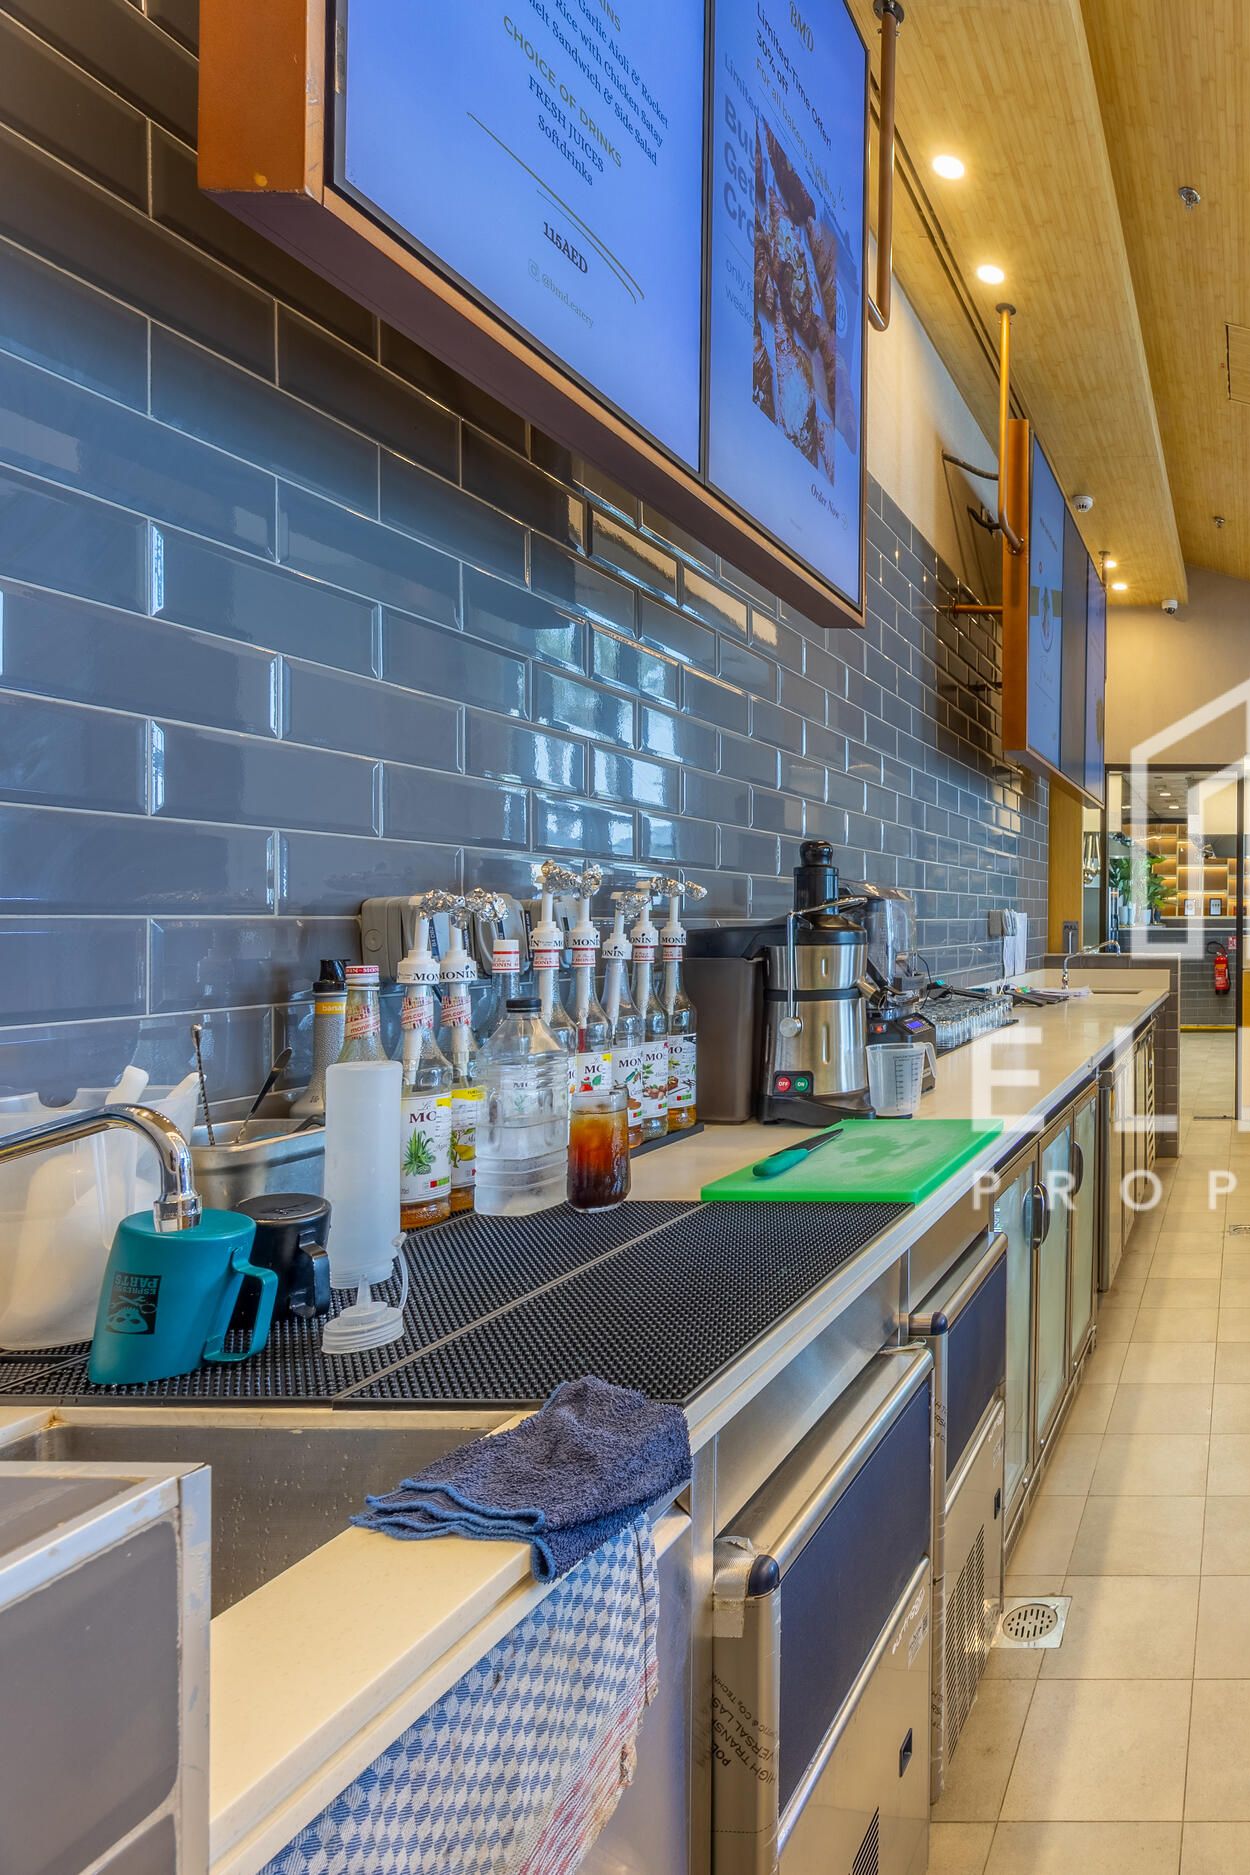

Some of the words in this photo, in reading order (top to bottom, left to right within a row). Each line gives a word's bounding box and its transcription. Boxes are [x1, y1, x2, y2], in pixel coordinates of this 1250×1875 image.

[503, 15, 556, 89] CHOICE
[559, 84, 576, 109] OF
[579, 107, 621, 168] DRINKS
[552, 21, 601, 94] Sandwich
[603, 88, 613, 105] &
[614, 102, 634, 135] Side
[634, 128, 657, 166] Salad
[578, 0, 607, 43] Garlic
[609, 40, 629, 75] Aioli
[631, 69, 640, 86] &
[641, 82, 669, 129] Rocket
[580, 29, 602, 64] with
[604, 61, 639, 116] Chicken
[641, 110, 663, 148] Satay
[756, 29, 776, 73] 30%
[776, 70, 789, 96] off
[756, 56, 771, 88] For
[529, 73, 567, 129] FRESH
[568, 121, 604, 173] JUICES
[537, 114, 593, 186] Softdrinks
[724, 141, 756, 208] Get
[543, 221, 588, 274] 115AED
